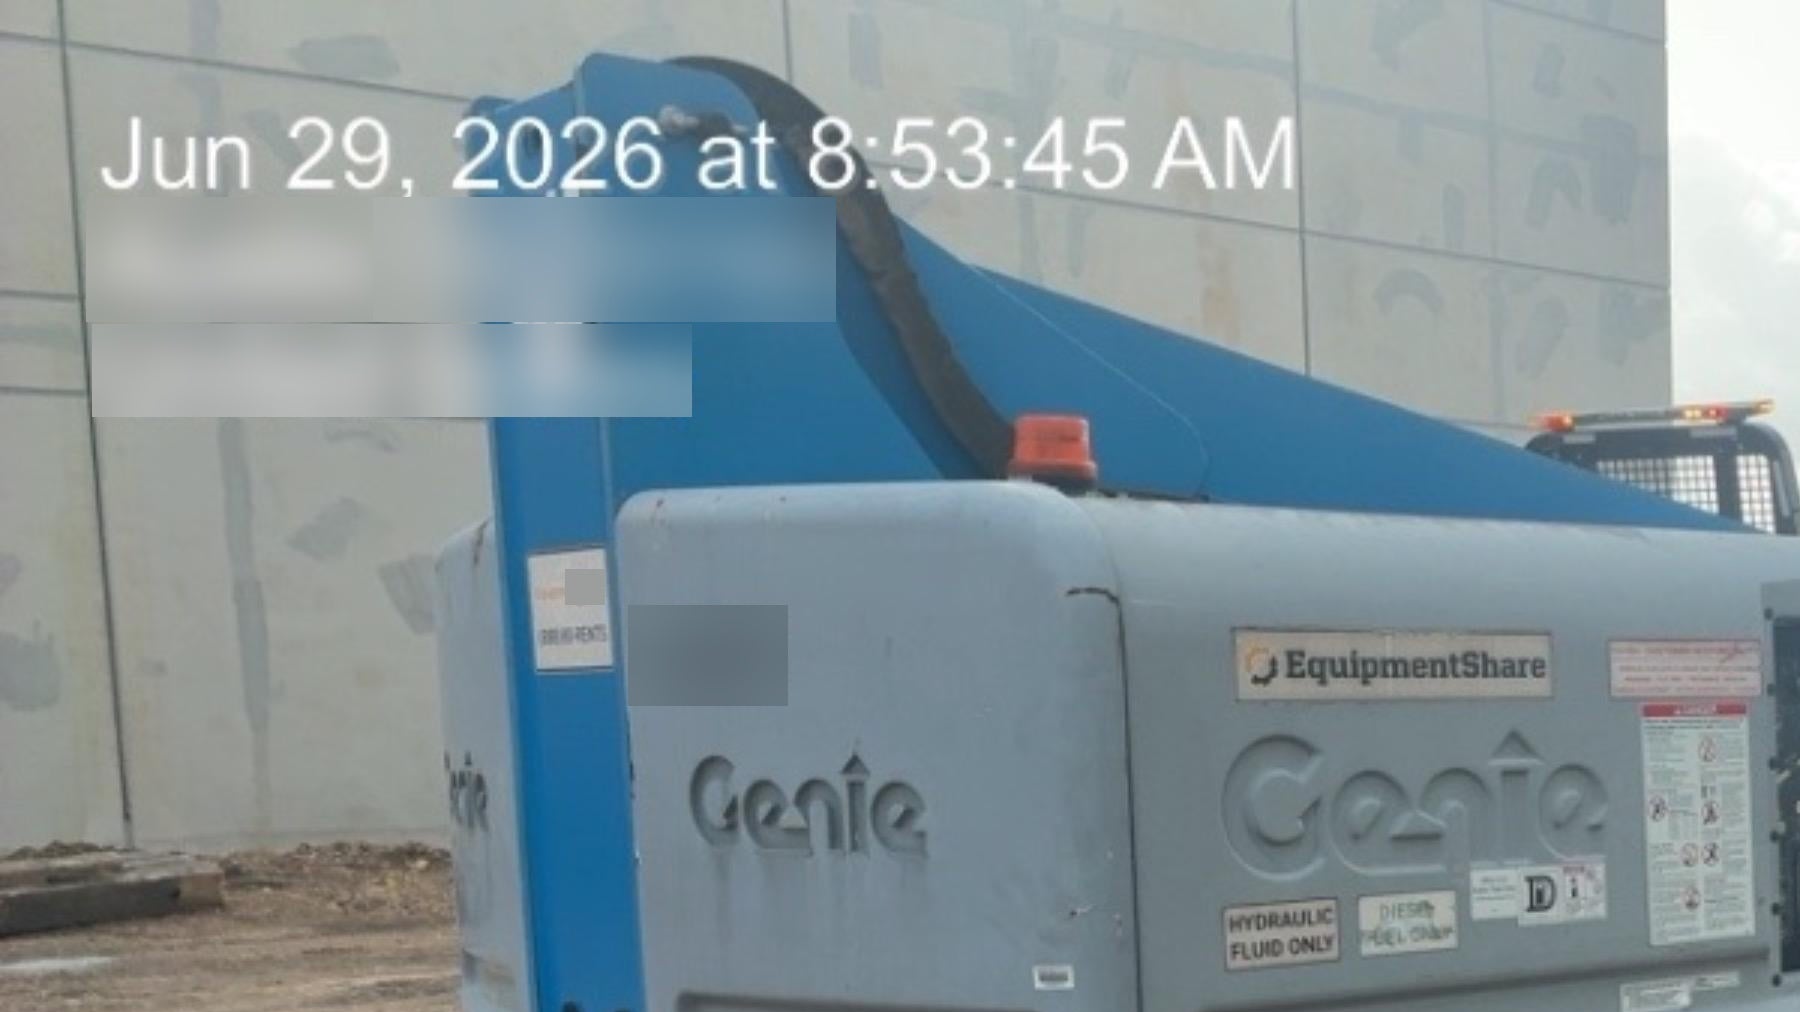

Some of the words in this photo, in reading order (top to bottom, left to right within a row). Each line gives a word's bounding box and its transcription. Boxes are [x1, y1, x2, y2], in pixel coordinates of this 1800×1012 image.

[1285, 650, 1547, 686] EquipmentShare
[689, 754, 929, 857] Genie
[1221, 728, 1610, 882] Genie
[1229, 907, 1334, 933] HYDRAULIC
[1230, 937, 1285, 961] FLUID
[1288, 933, 1335, 956] ONLY
